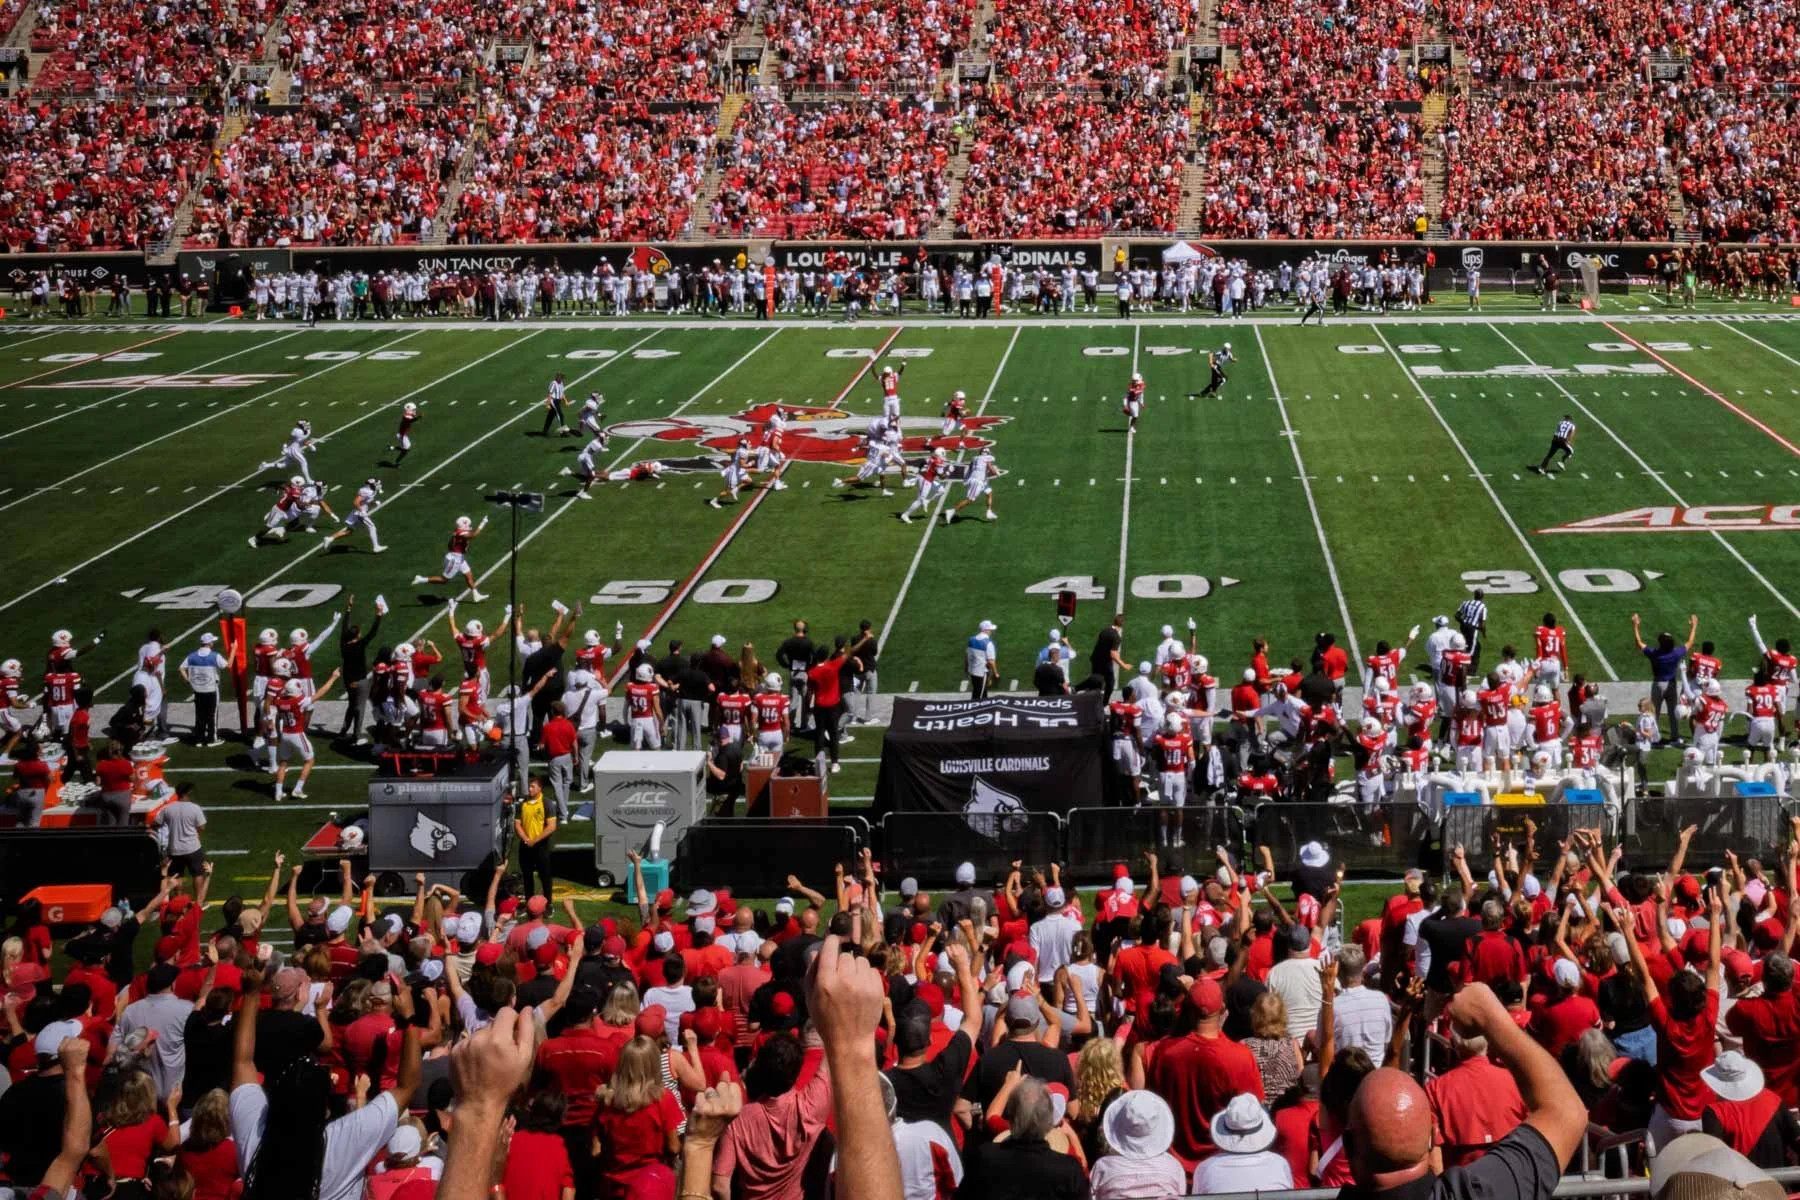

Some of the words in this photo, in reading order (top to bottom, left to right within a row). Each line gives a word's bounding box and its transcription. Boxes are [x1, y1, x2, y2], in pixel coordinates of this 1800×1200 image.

[418, 258, 447, 271] SUN
[450, 258, 482, 270] TAN
[485, 257, 521, 270] CITY
[1332, 250, 1368, 263] Kroger
[1464, 254, 1481, 266] ups
[1585, 254, 1619, 267] NC
[590, 579, 776, 604] 50
[1546, 636, 1560, 652] 31
[53, 686, 66, 701] 81
[632, 697, 648, 712] 39
[924, 697, 1009, 711] Medicine
[1487, 702, 1505, 720] 43
[762, 707, 778, 723] 46
[913, 711, 1019, 731] Health
[1547, 718, 1556, 736] 6
[940, 758, 994, 774] LOUISVILLE
[994, 757, 1050, 773] CARDINALS
[137, 766, 149, 781] G
[398, 782, 435, 794] planet
[439, 782, 481, 793] fitness
[622, 791, 670, 805] ACC
[48, 906, 64, 922] G
